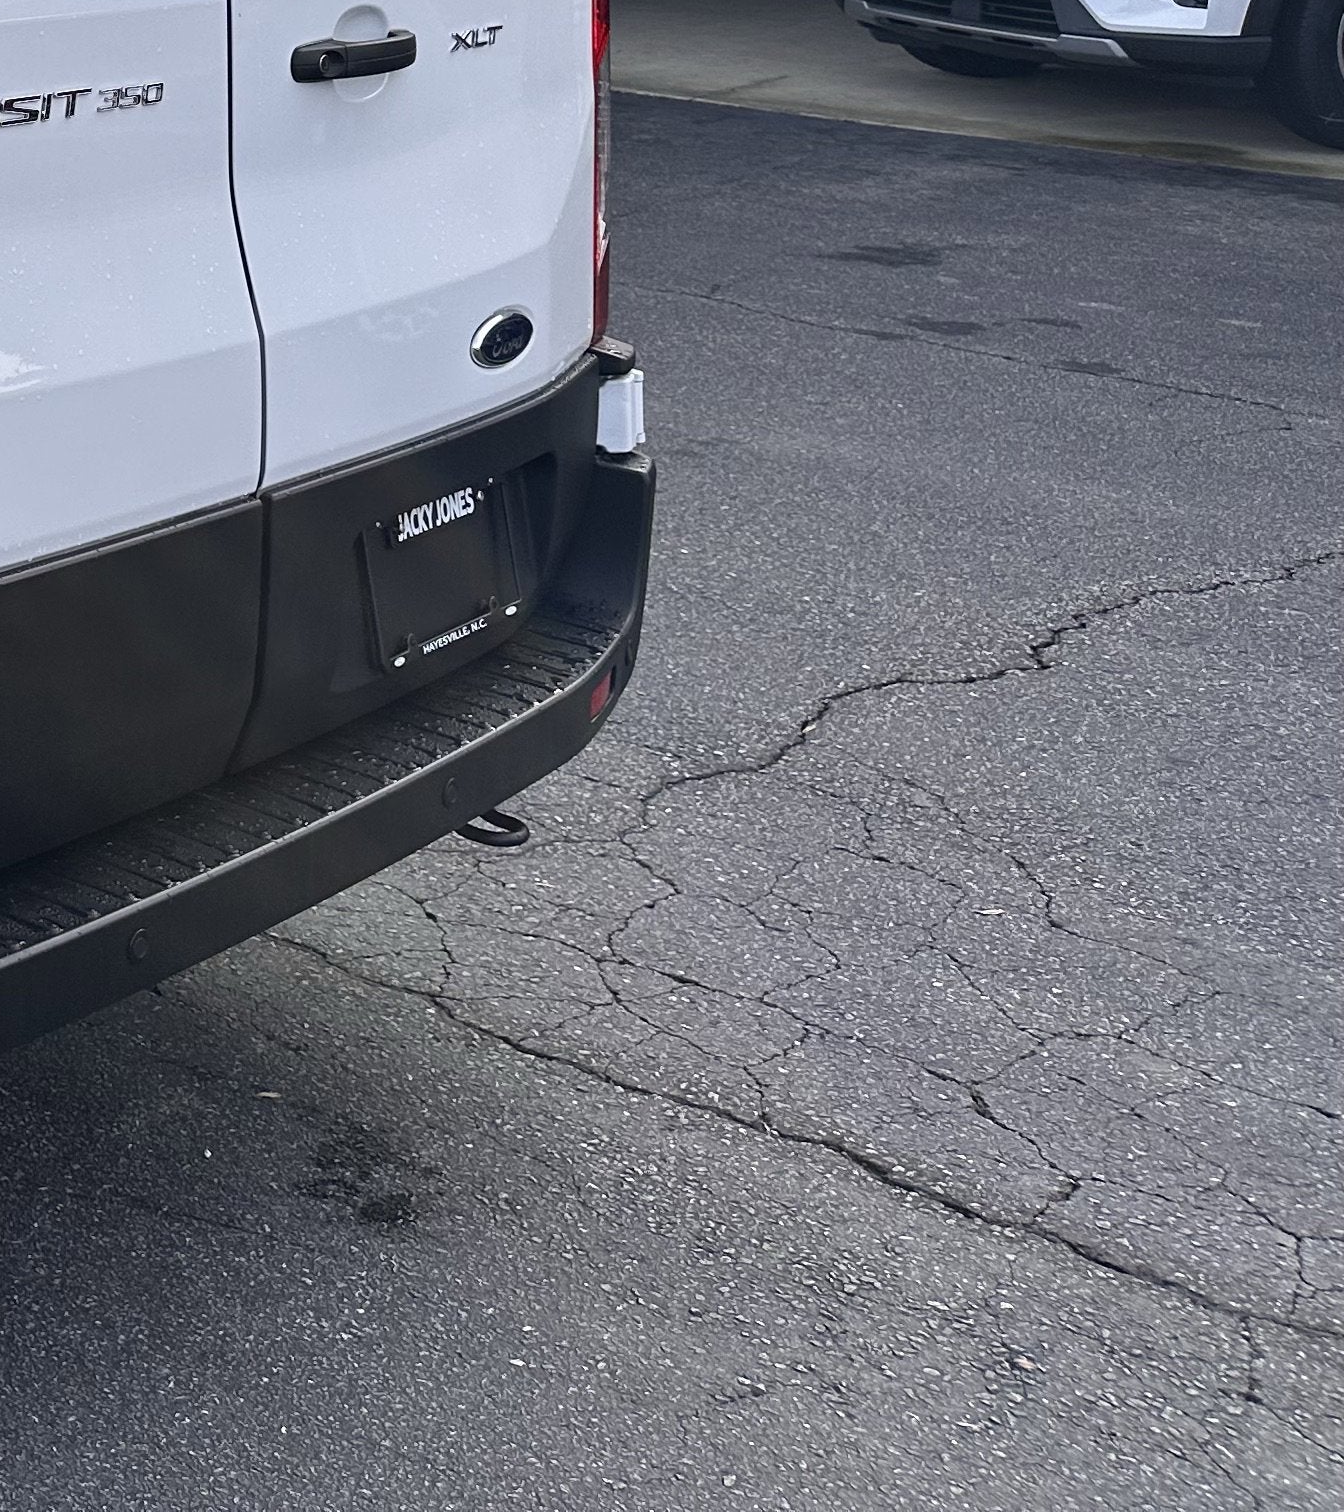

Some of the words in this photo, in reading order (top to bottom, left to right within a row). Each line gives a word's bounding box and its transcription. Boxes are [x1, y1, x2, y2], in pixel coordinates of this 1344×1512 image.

[449, 25, 503, 53] XLT
[96, 82, 164, 114] 350
[398, 502, 433, 542] JACKY
[435, 487, 475, 526] JONES
[470, 619, 488, 637] N.C.
